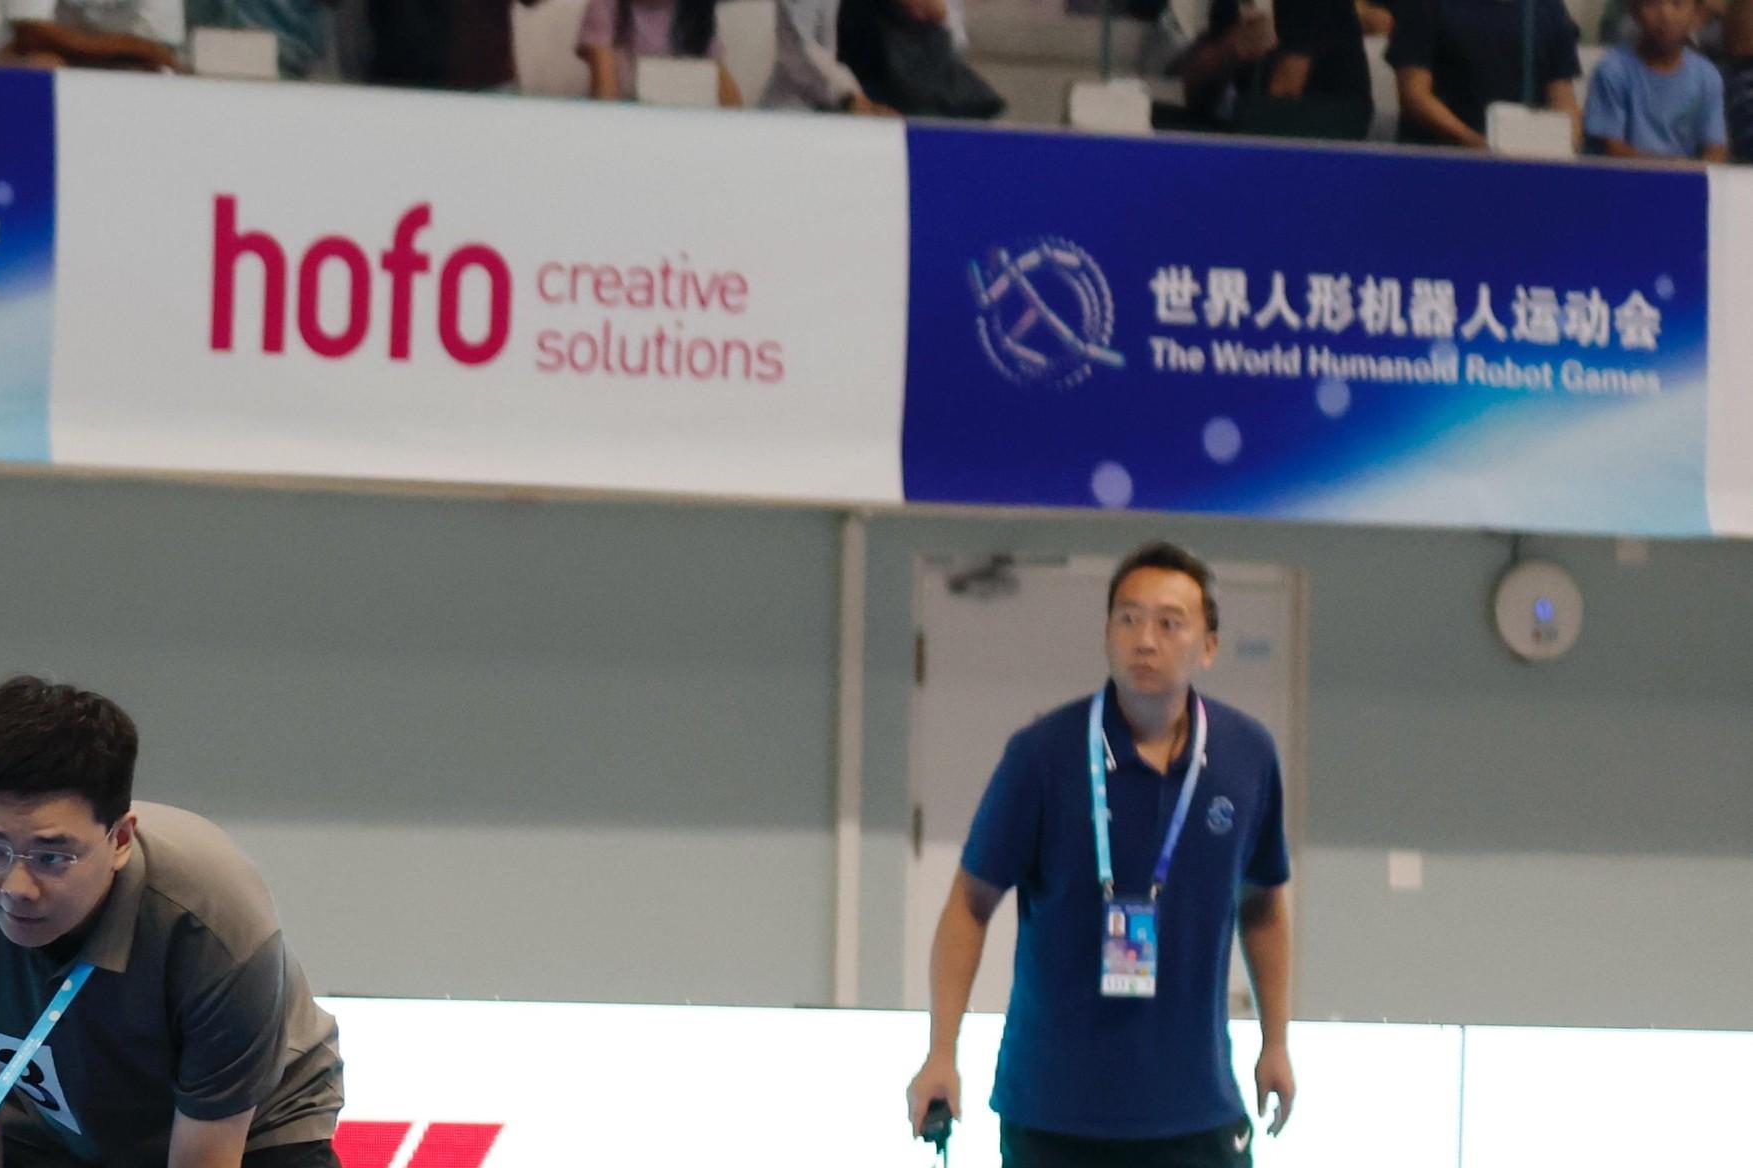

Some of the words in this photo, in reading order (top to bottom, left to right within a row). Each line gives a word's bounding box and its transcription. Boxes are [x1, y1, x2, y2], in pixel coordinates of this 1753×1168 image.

[210, 194, 513, 367] hofo
[536, 251, 749, 315] creative
[1149, 265, 1661, 351] 世界人形机器人运动会
[535, 322, 785, 384] solutions
[1149, 335, 1205, 372] The
[1211, 339, 1301, 377] World
[1306, 344, 1459, 385] Humanoid
[1465, 353, 1553, 390] Robot
[1560, 358, 1660, 394] Games
